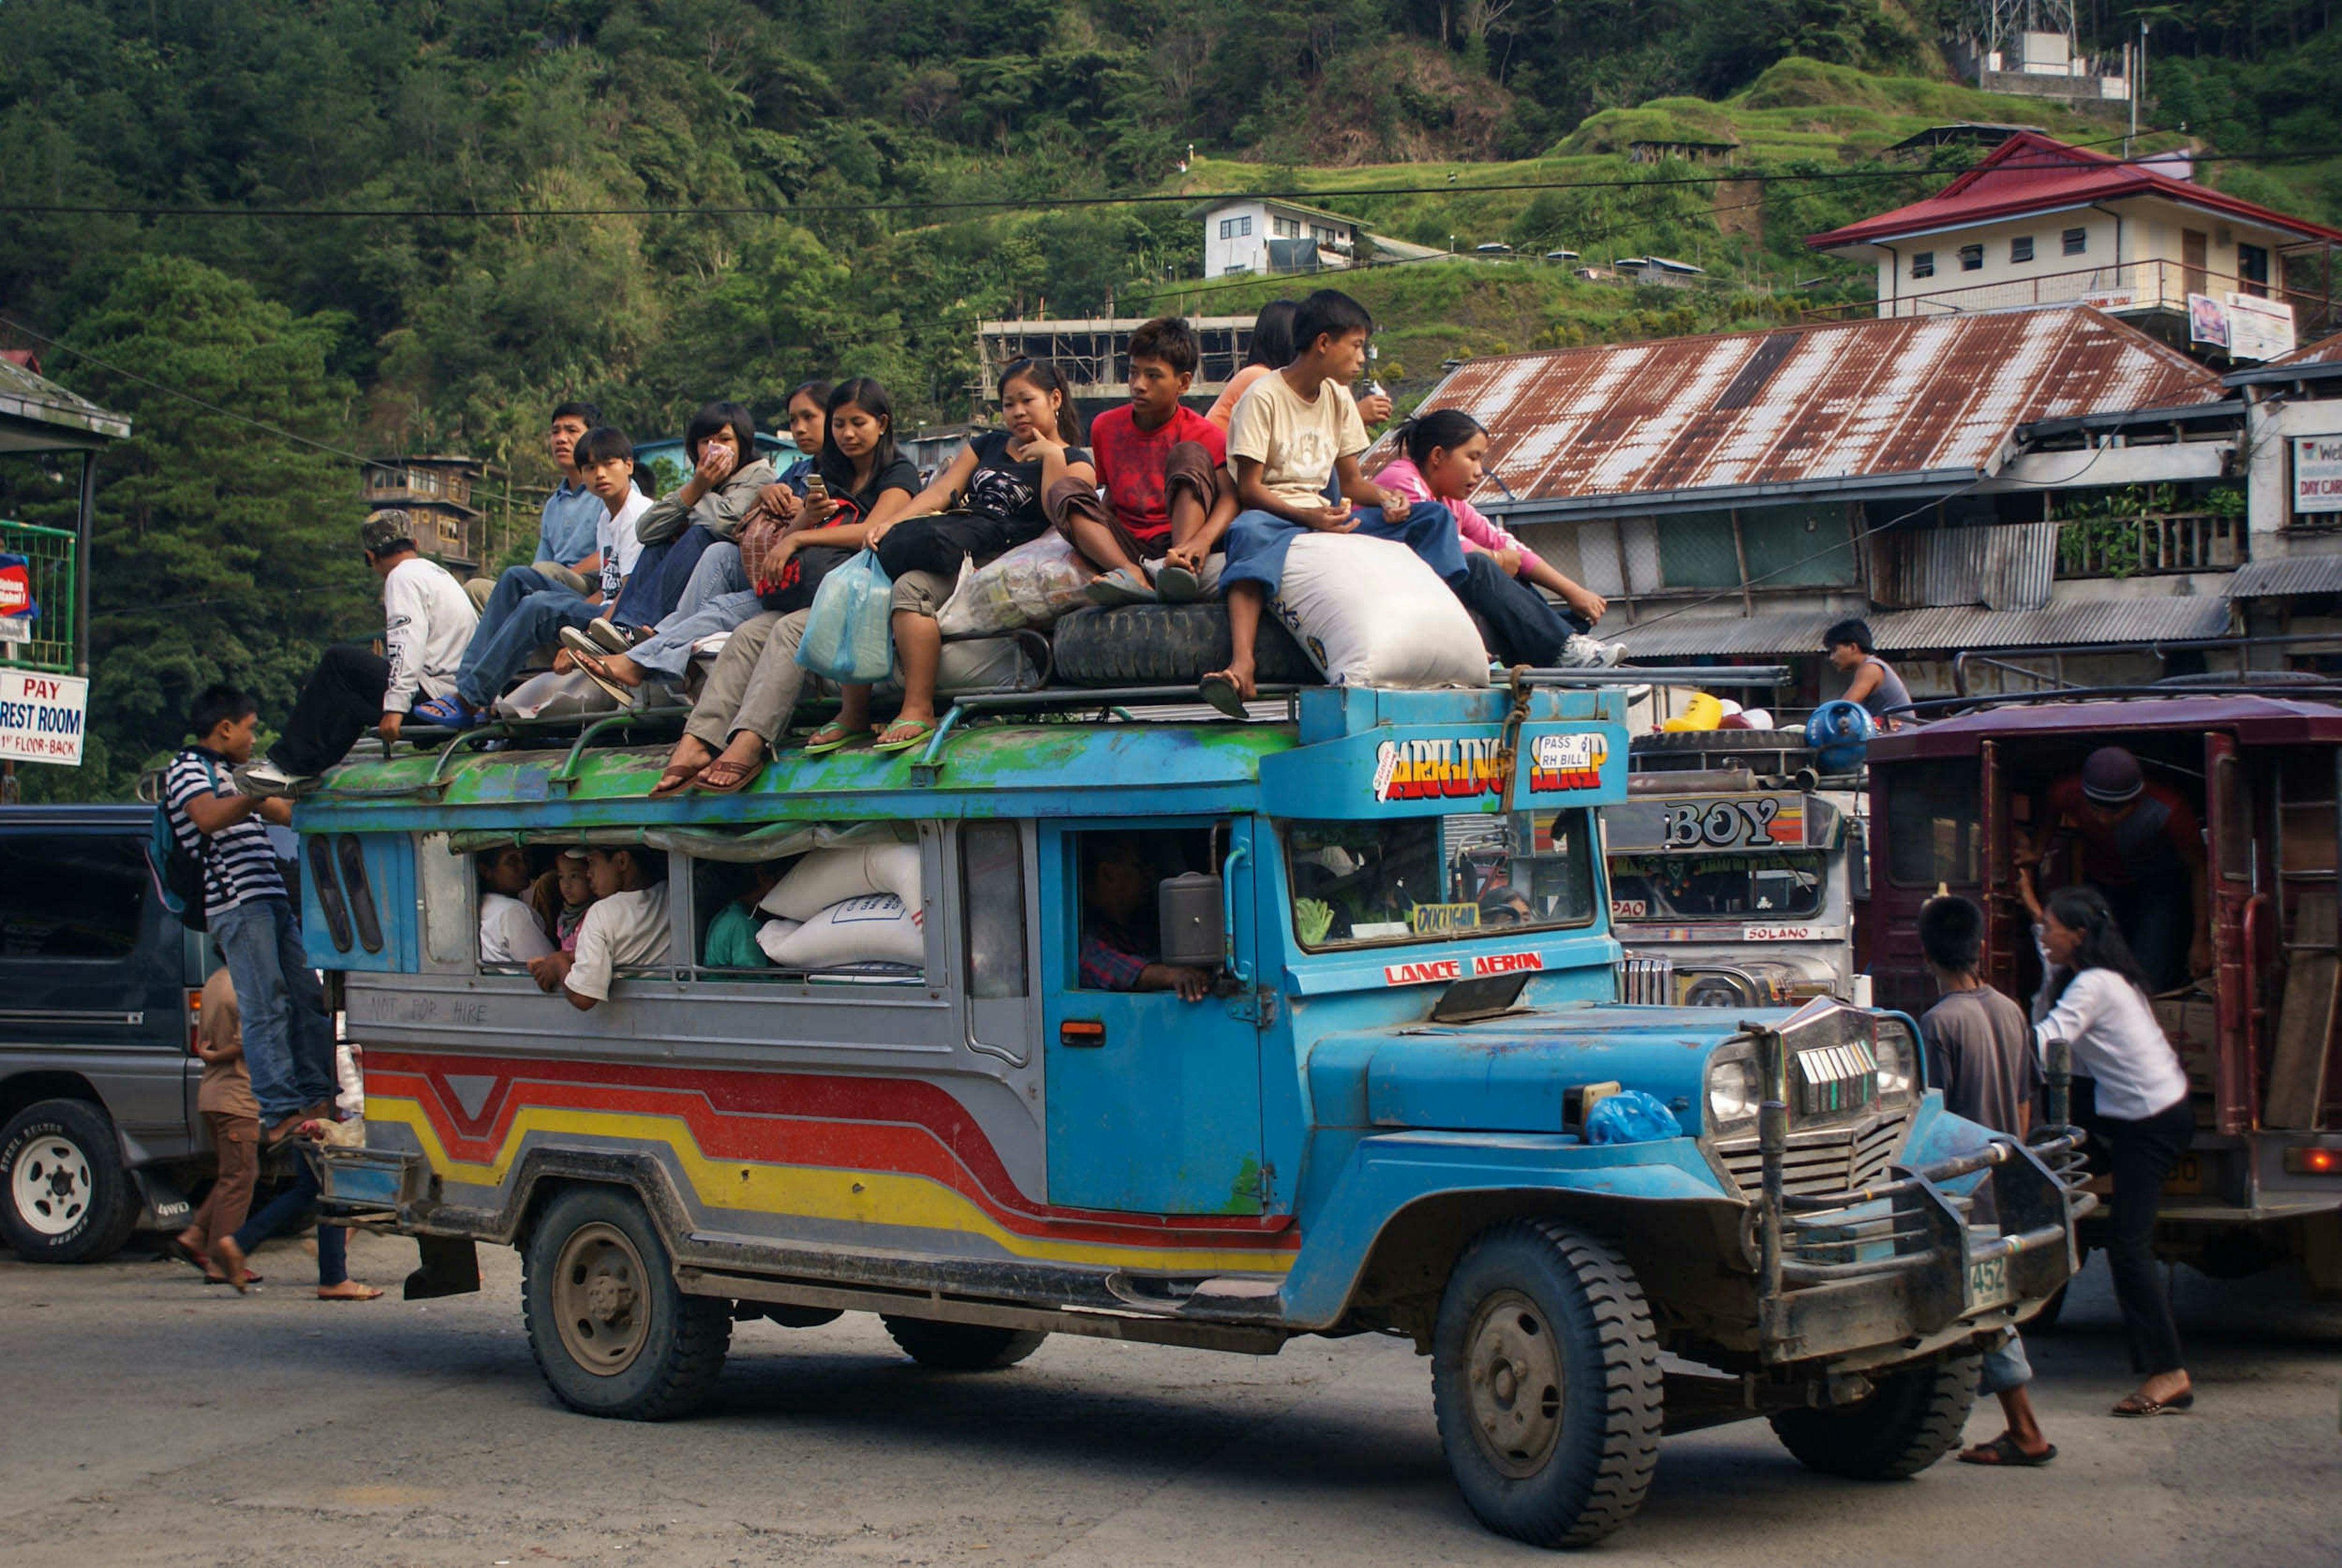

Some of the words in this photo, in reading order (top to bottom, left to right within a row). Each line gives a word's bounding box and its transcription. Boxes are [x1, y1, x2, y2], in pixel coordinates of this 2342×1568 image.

[23, 678, 60, 700] PAY
[0, 701, 35, 730] REST
[38, 706, 81, 734] ROOM
[1544, 737, 1570, 749] PASS
[1543, 755, 1558, 766] RH
[1664, 798, 1779, 847] BOY
[1749, 928, 1808, 939] SOLANO
[1384, 961, 1461, 984] LANCE
[1475, 951, 1541, 975] AERON
[371, 997, 399, 1021] NOT
[410, 997, 438, 1020] FOR
[454, 999, 487, 1023] HIRE
[158, 1201, 190, 1216] 4WD
[1973, 1259, 2005, 1294] 452
